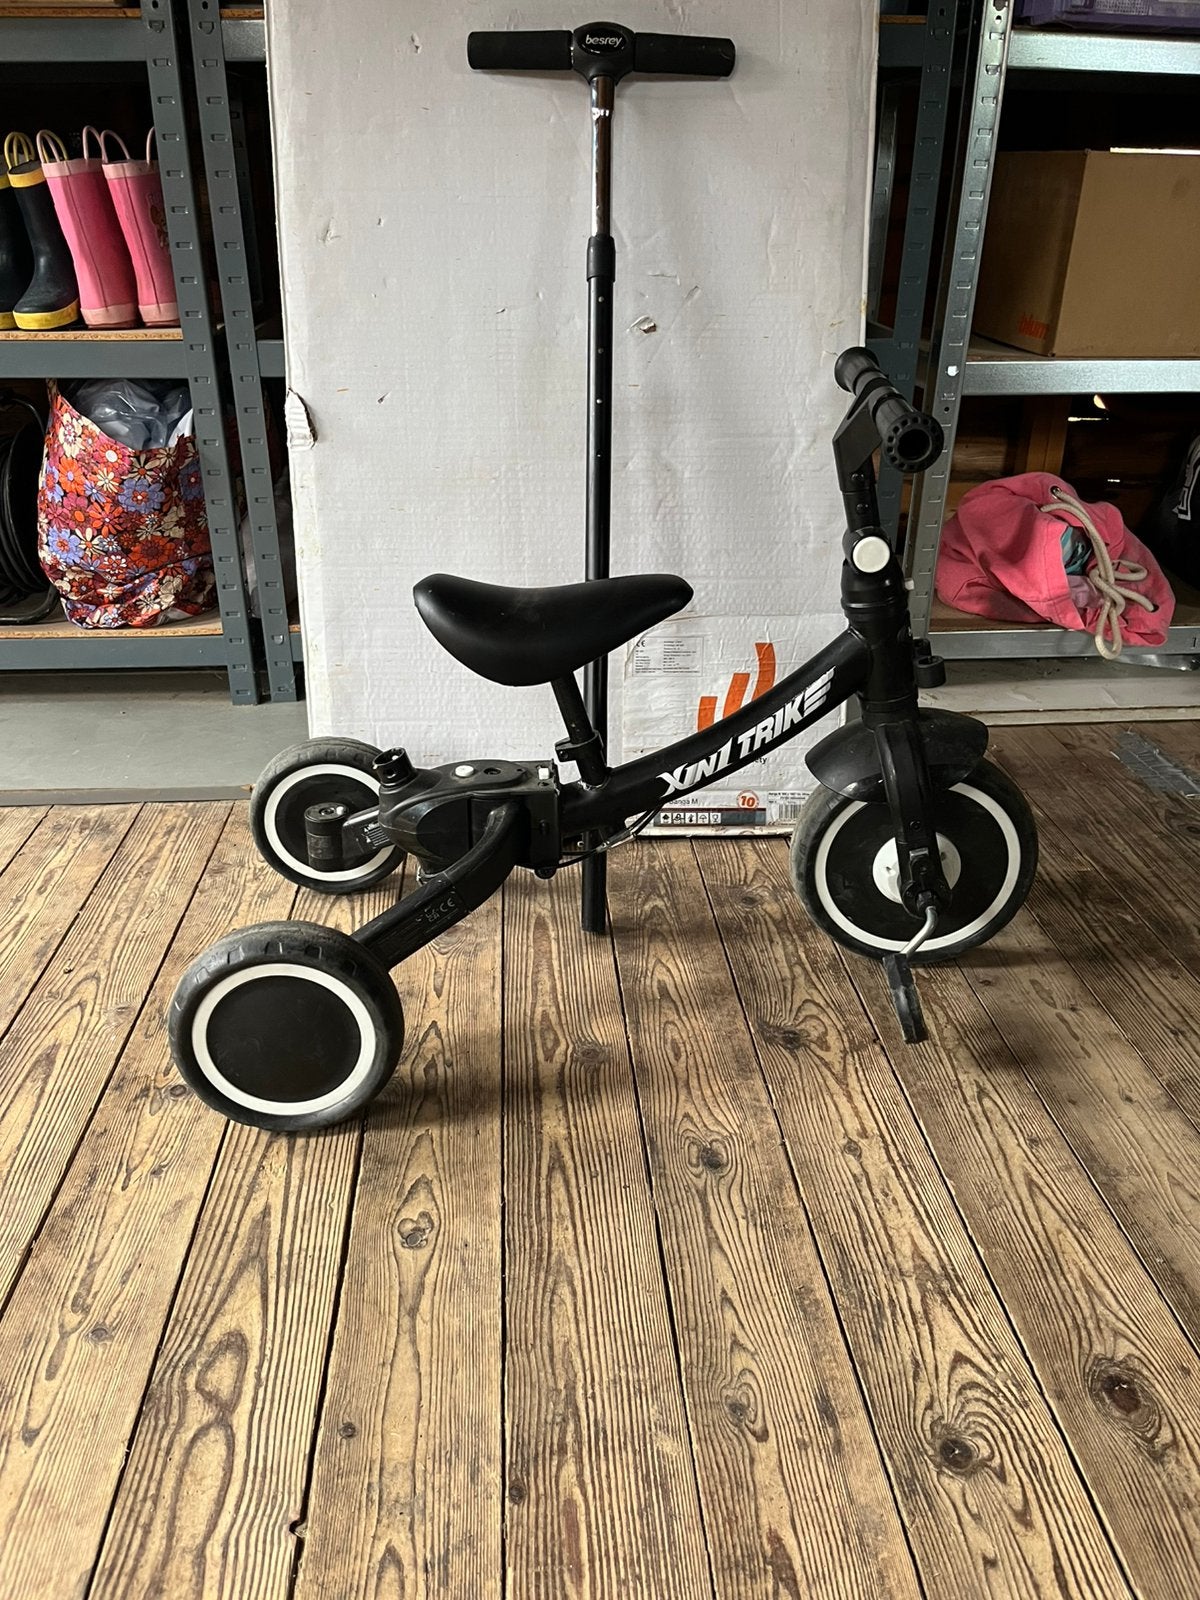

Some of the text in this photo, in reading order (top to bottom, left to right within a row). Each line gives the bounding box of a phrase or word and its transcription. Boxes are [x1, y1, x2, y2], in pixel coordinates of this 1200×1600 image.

[585, 34, 622, 48] besrey
[738, 666, 836, 759] TRIKE
[741, 795, 756, 807] 10
